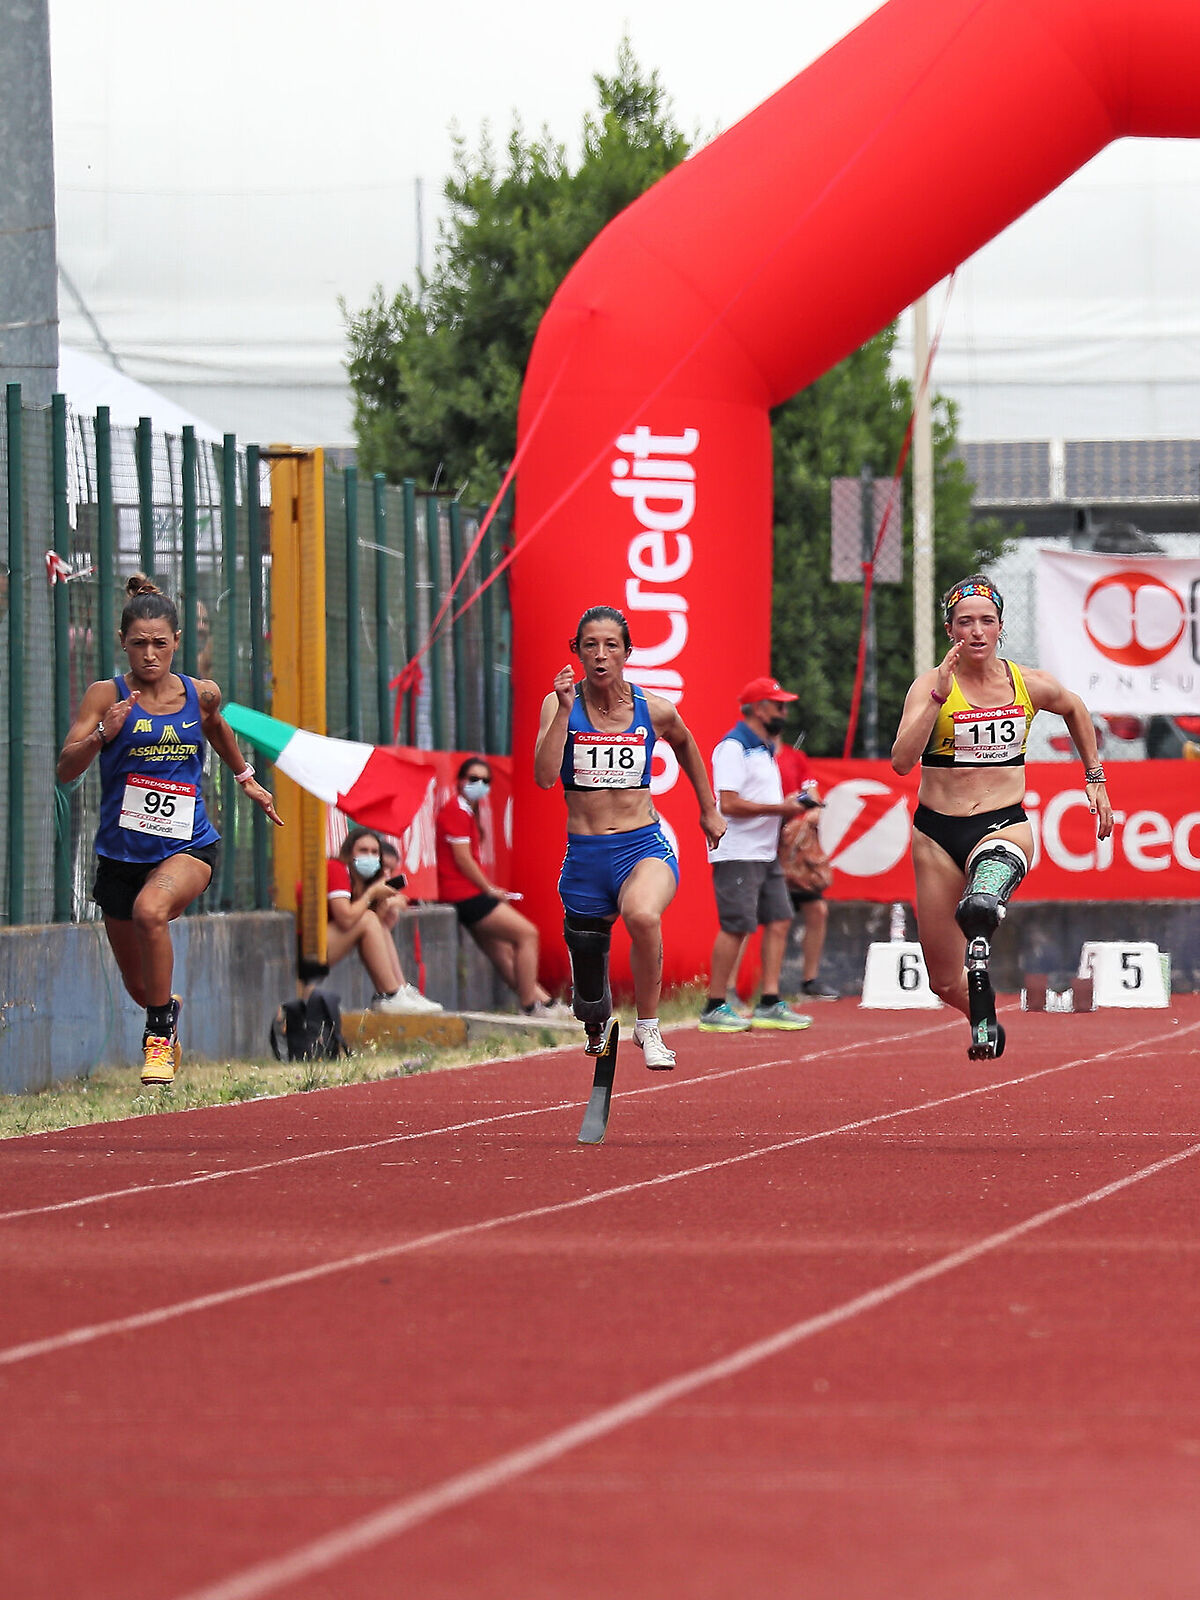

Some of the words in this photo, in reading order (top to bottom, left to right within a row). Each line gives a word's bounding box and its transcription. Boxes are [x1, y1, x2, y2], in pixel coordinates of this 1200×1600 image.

[968, 720, 1016, 744] 113
[128, 744, 198, 757] ASSINDUSTRI
[586, 747, 635, 769] 118
[982, 751, 1008, 759] UniCredit
[600, 776, 627, 784] UniCredit
[143, 791, 176, 817] 95
[146, 822, 173, 833] UniCredit
[899, 953, 920, 990] 6
[1121, 952, 1142, 990] 5
